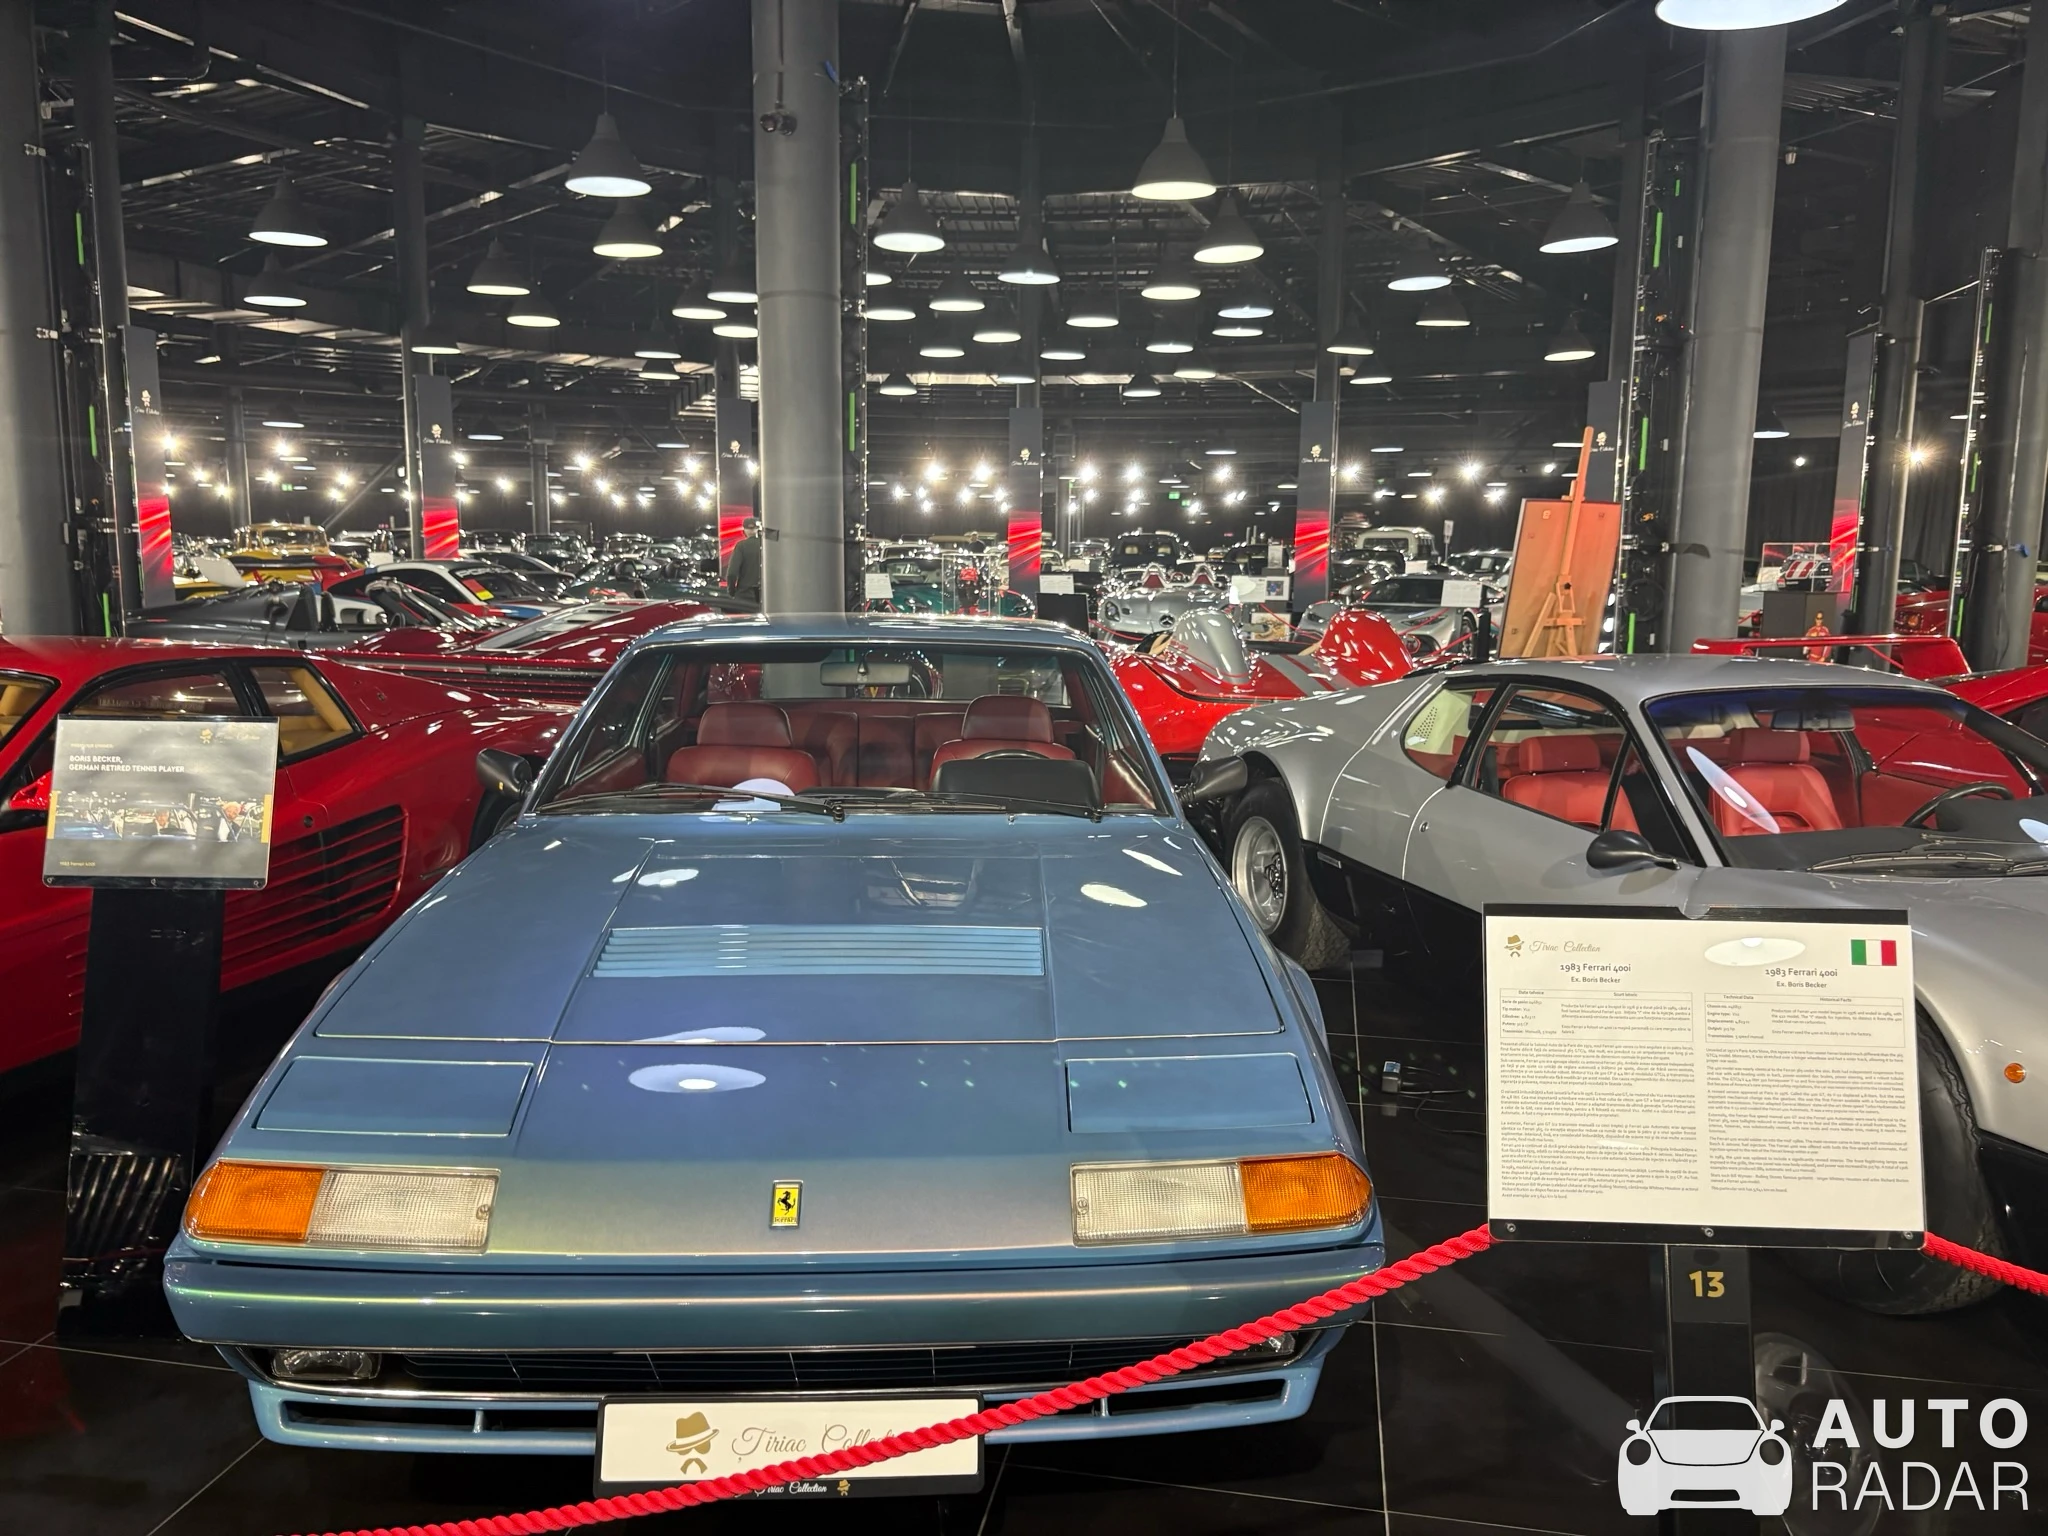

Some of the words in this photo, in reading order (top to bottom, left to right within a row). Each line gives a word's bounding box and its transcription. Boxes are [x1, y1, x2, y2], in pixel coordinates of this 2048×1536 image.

[92, 755, 123, 764] BECKER,
[69, 763, 99, 771] GERMAN
[101, 764, 131, 772] RETIRED
[158, 765, 185, 773] PLAYER
[1563, 940, 1601, 953] Collection
[1559, 963, 1581, 973] 1983
[1582, 963, 1612, 972] Ferrari
[1613, 963, 1631, 974] 400i
[1764, 968, 1786, 978] 1983
[1788, 968, 1818, 977] Ferrari
[1819, 968, 1838, 978] 400i
[1599, 976, 1621, 984] Becker
[1805, 981, 1827, 989] Becker
[1688, 1270, 1726, 1299] 13
[731, 1426, 807, 1463] Țiriac
[788, 1481, 828, 1494] Collection
